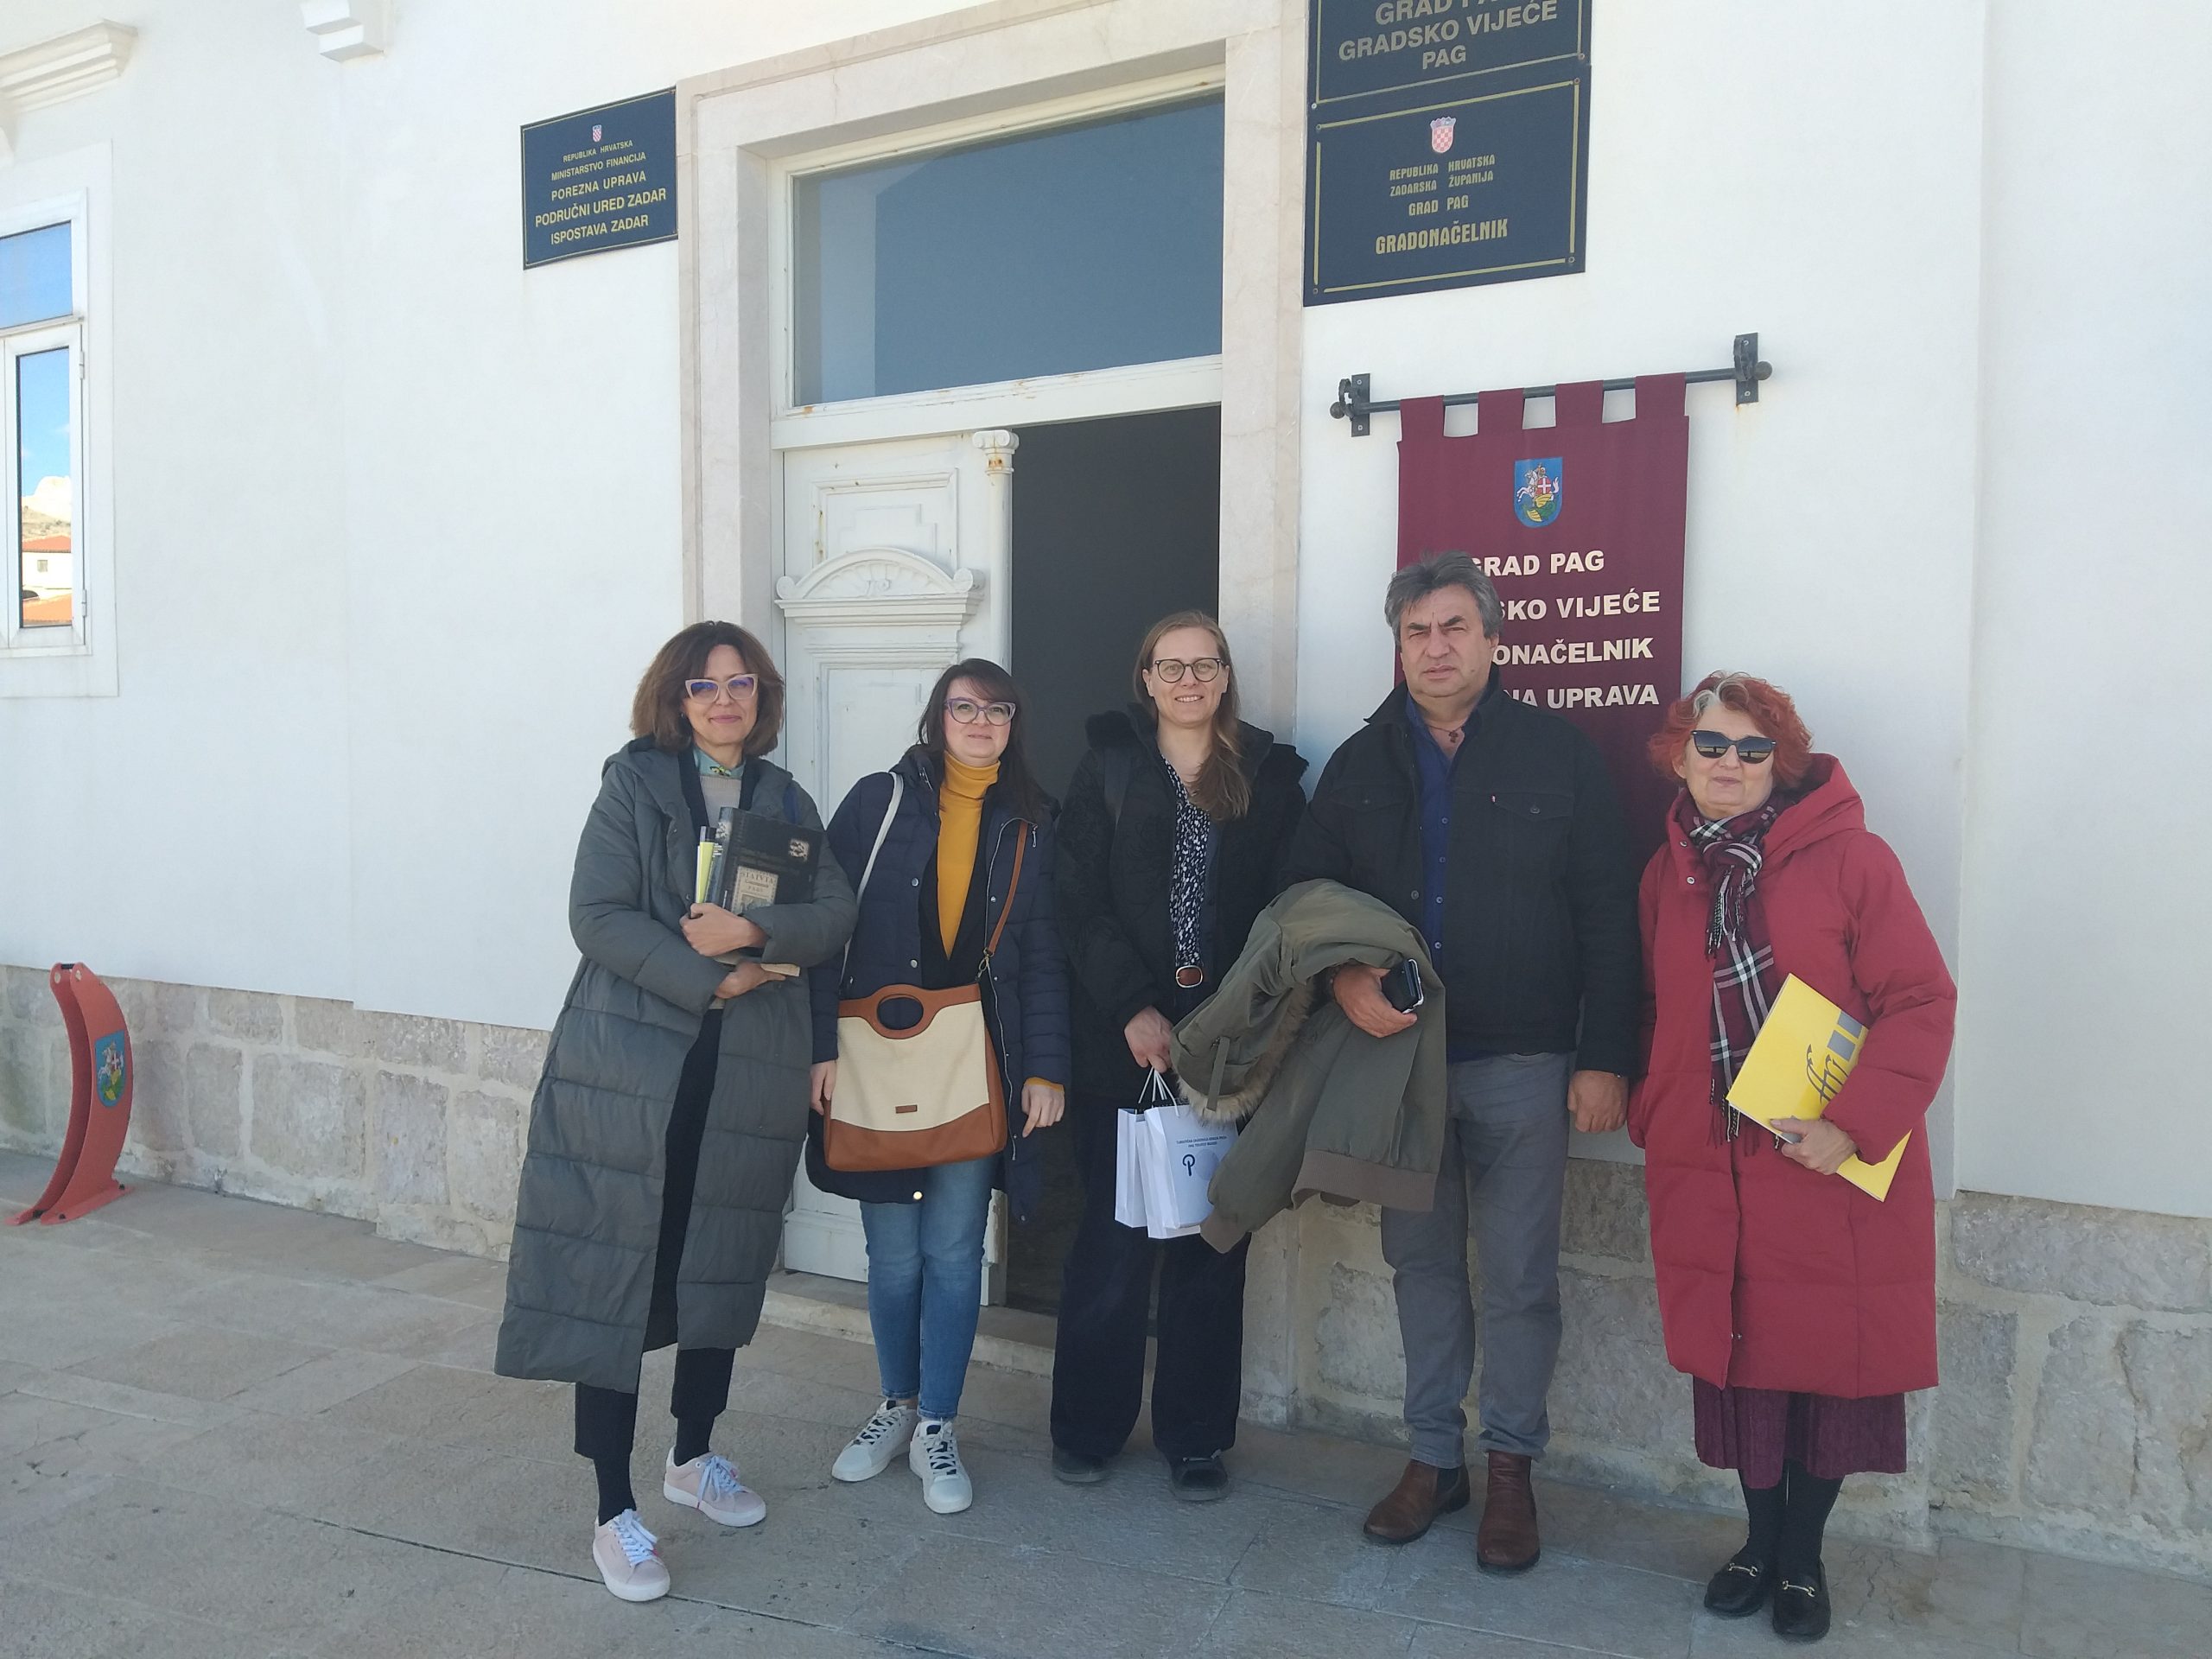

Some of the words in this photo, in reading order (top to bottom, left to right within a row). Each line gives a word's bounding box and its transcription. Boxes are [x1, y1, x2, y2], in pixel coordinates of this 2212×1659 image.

[1376, 0, 1452, 25] GRAD
[1339, 20, 1459, 61] GRADSKO
[1422, 45, 1466, 69] PAG
[563, 149, 596, 163] REPUBLIKA
[600, 140, 633, 154] HRVATSKA
[551, 161, 603, 181] MINISTARSTVO
[606, 151, 646, 168] FINANCIJA
[1389, 163, 1439, 181] REPUBLIKA
[1448, 154, 1496, 172] HRVATSKA
[551, 181, 600, 200] POREZNA
[603, 170, 646, 189] UPRAVA
[1389, 180, 1437, 197] ZADARSKA
[1448, 170, 1494, 188] ŽUPANIJA
[535, 203, 590, 227] PODRUČNI
[593, 197, 625, 214] URED
[627, 188, 666, 207] ZADAR
[1408, 200, 1439, 216] GRAD
[1446, 194, 1469, 210] PAG
[550, 224, 607, 245] ISPOSTAVA
[611, 214, 648, 232] ZADAR
[1376, 219, 1509, 255] GRADONAČELNIK
[1550, 550, 1605, 575] PAG
[1556, 588, 1661, 619] VIJEĆE
[1492, 638, 1654, 665] ONAČELNIK
[1547, 683, 1660, 709] UPRAVA
